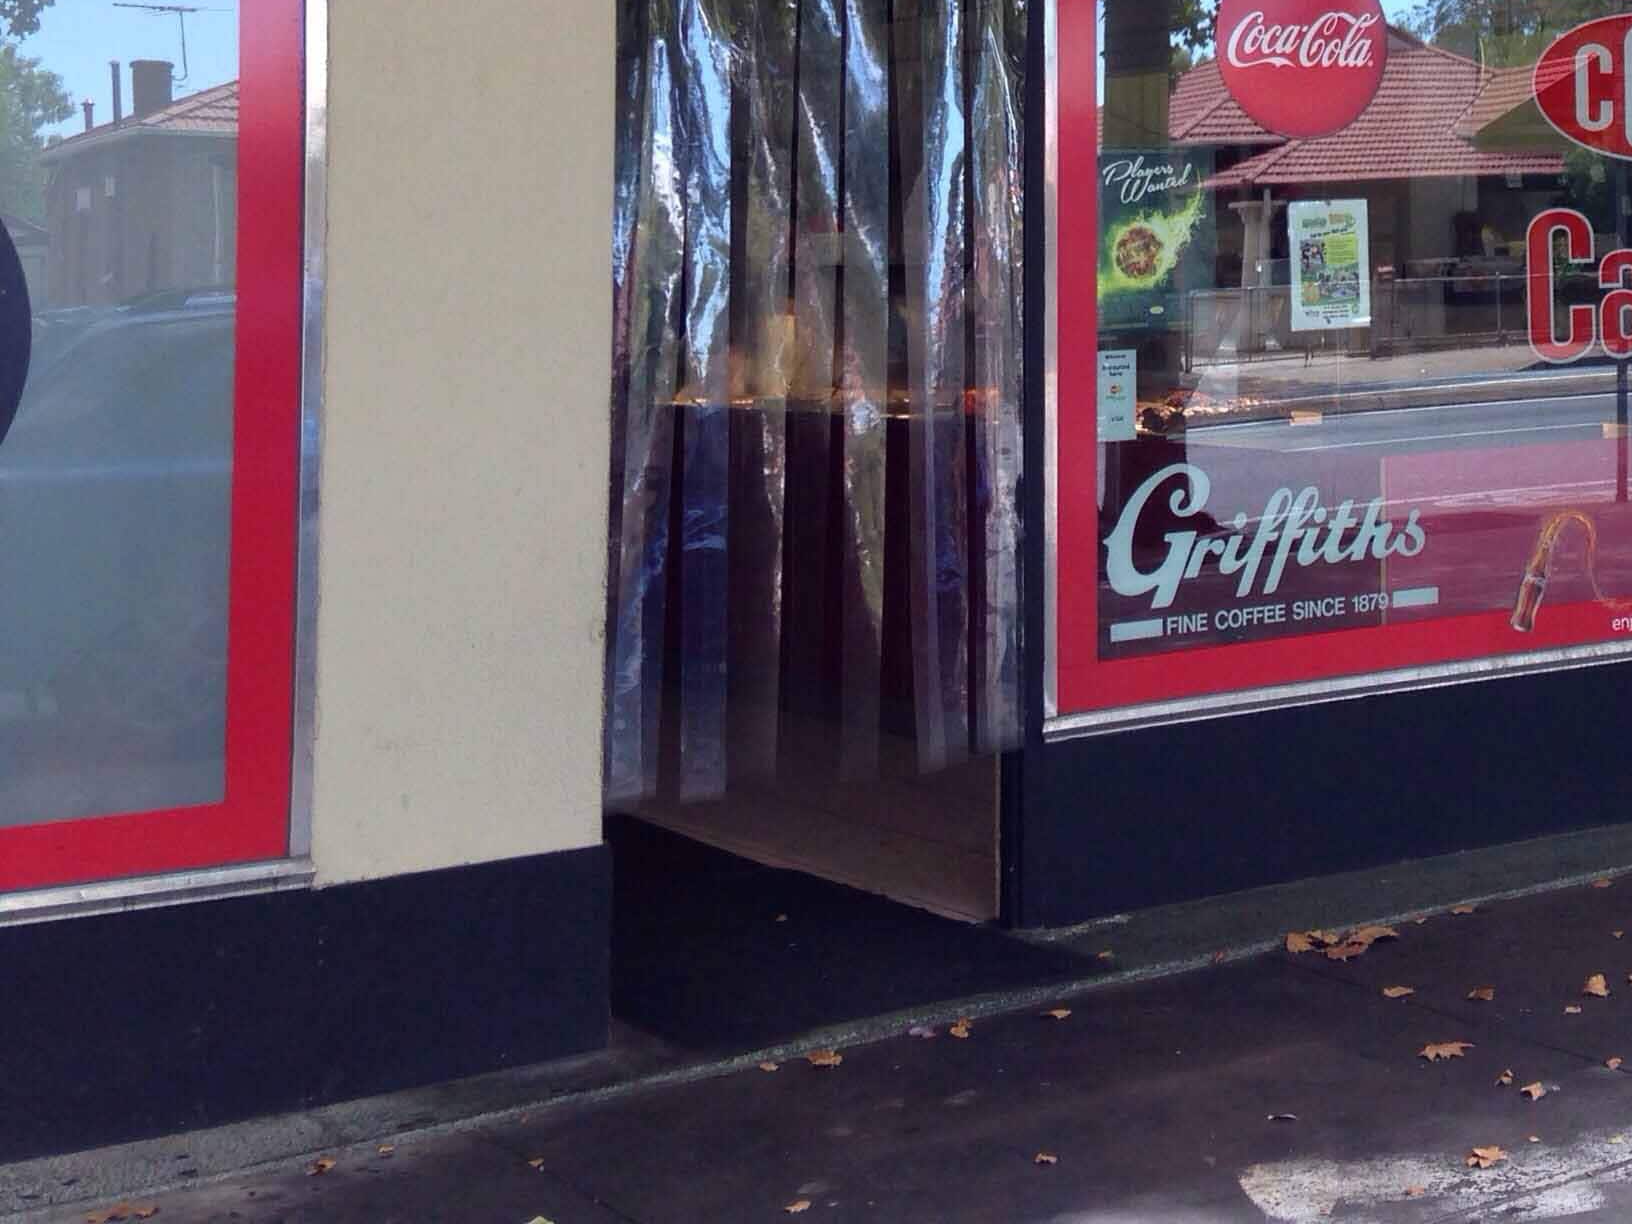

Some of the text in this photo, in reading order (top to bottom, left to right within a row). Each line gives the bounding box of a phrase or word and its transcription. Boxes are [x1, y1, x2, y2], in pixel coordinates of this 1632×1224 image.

[1102, 156, 1174, 186] Players
[1119, 163, 1193, 204] Wanted
[1103, 463, 1426, 609] Griffiths
[1166, 592, 1390, 636] FINE COFFEE SINCE 1879
